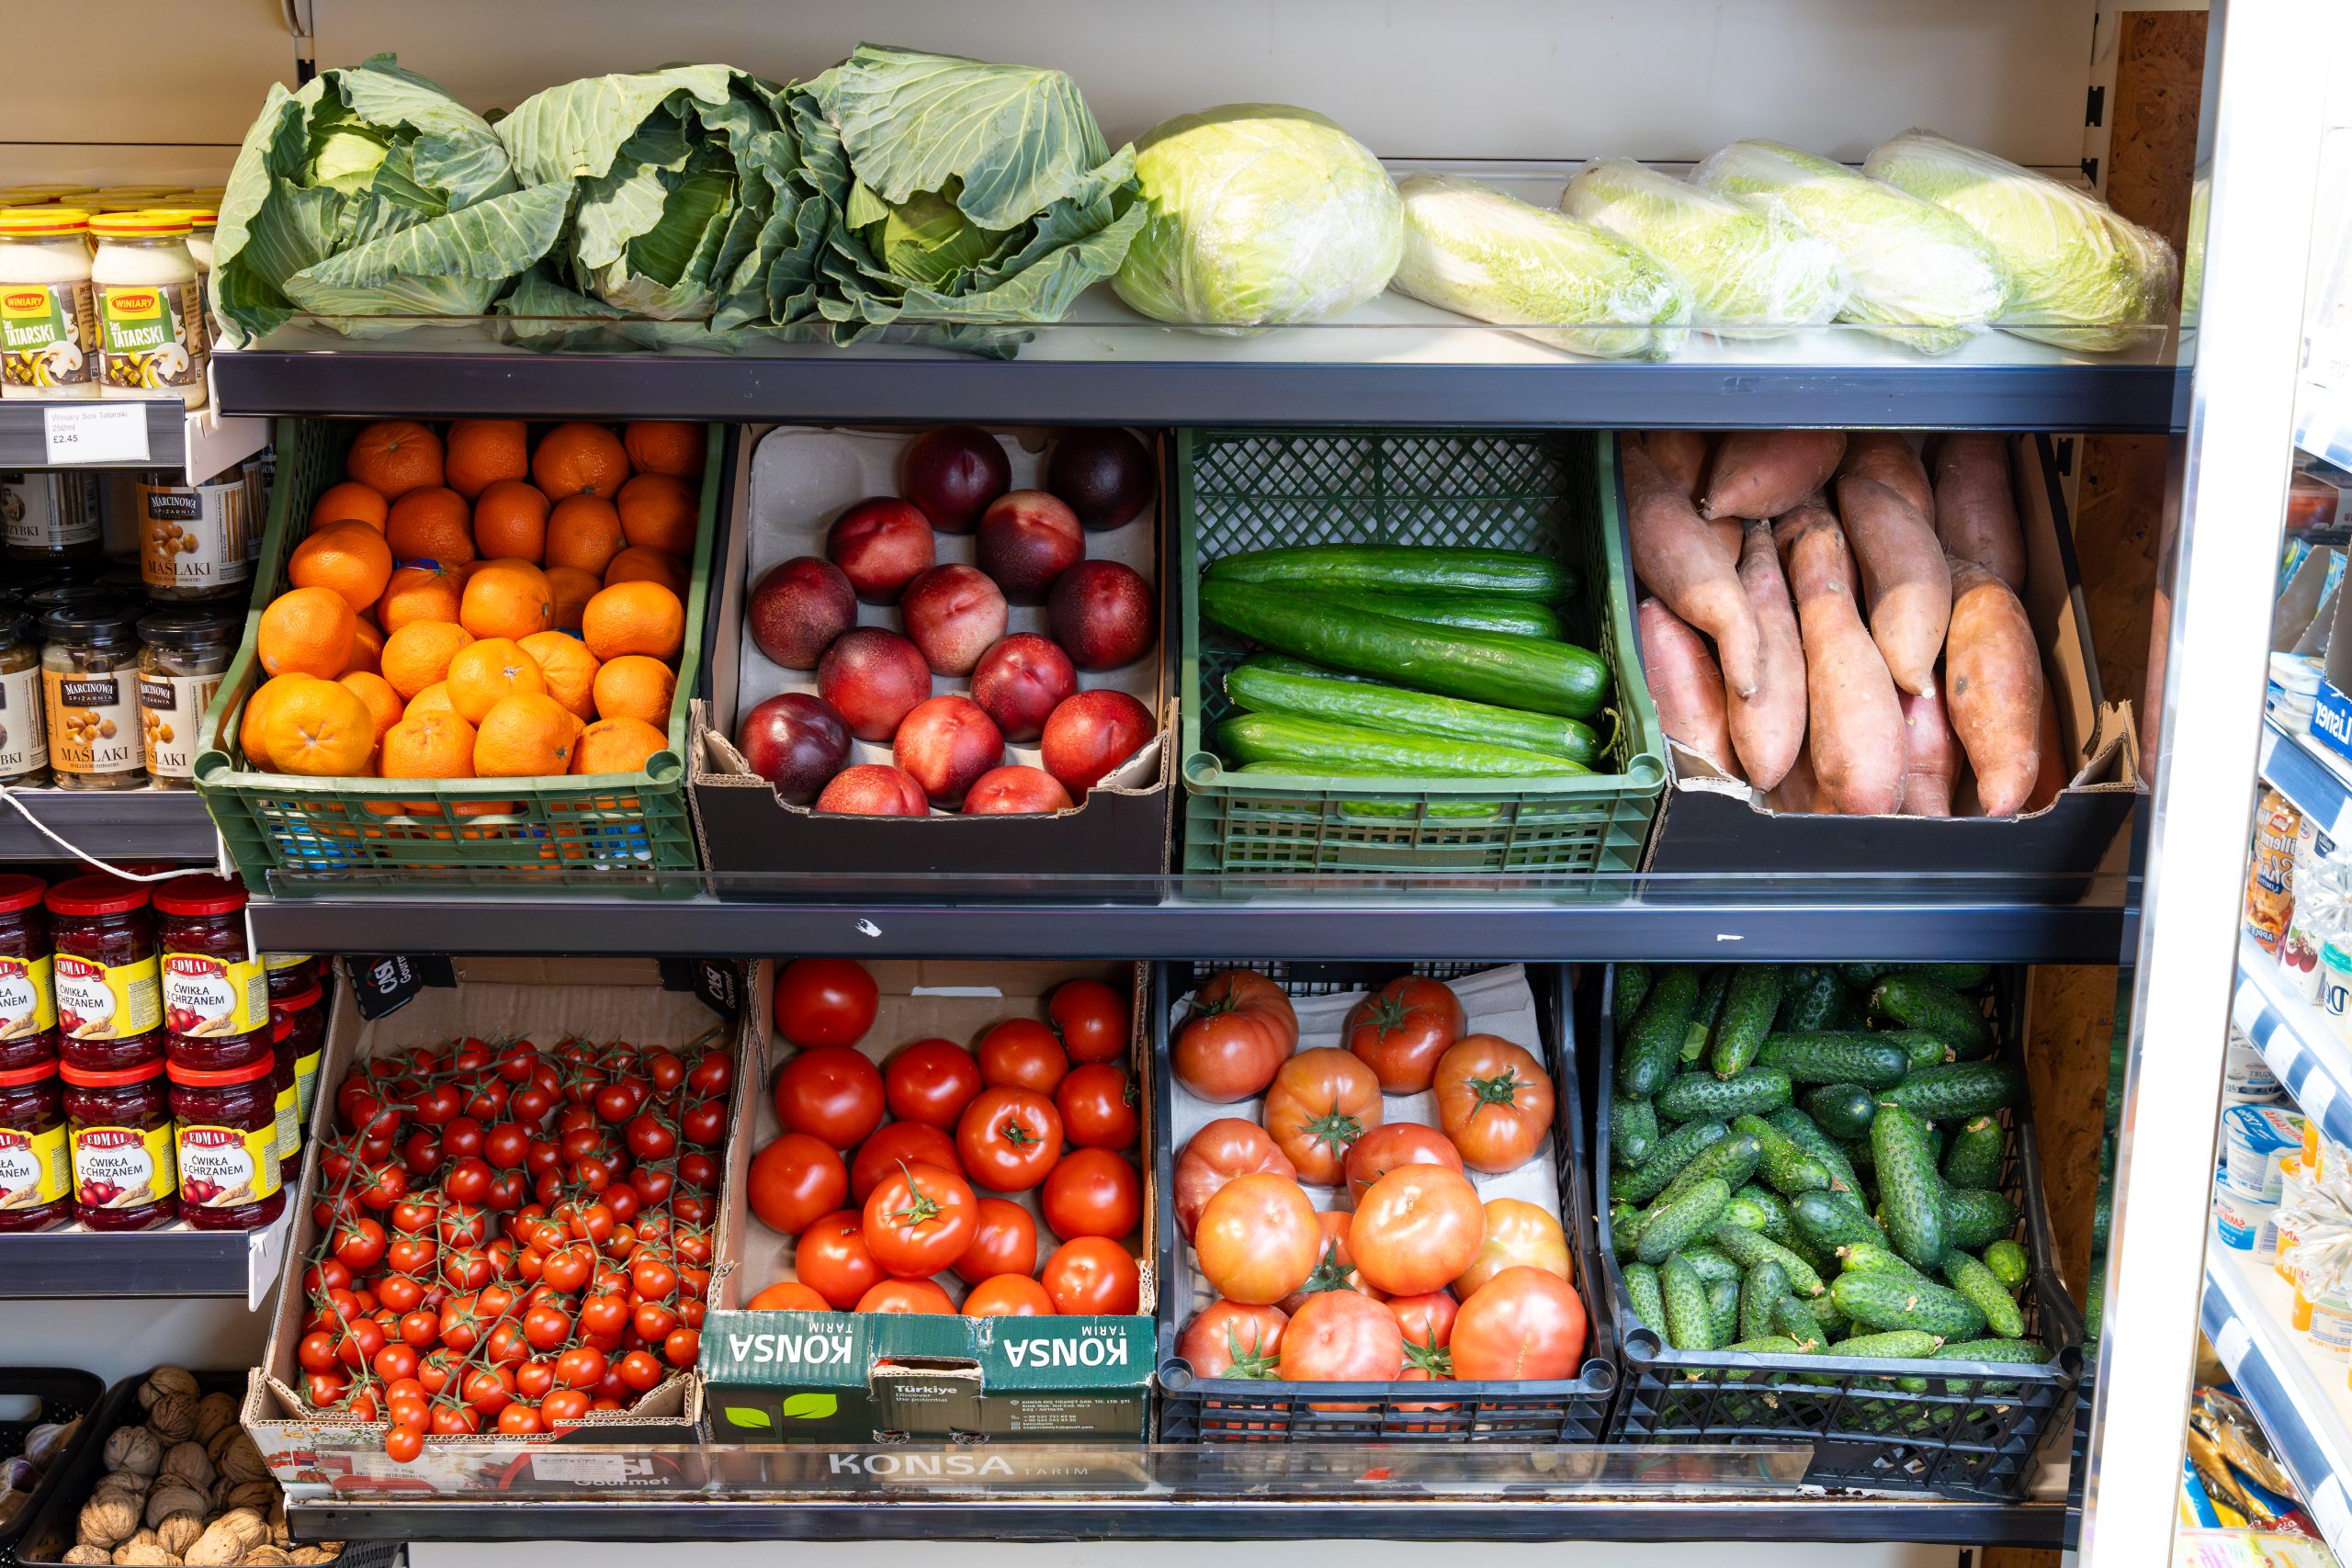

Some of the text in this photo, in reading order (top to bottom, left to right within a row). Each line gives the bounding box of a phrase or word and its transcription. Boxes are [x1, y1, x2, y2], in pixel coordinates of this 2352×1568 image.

[6, 297, 43, 307] WINIARY
[115, 299, 153, 309] WINIARY
[82, 412, 97, 421] Sos
[99, 411, 129, 420] Tatarski
[51, 423, 75, 433] 250ml
[52, 434, 79, 444] £2.45
[151, 495, 197, 510] MARCINOWA
[147, 559, 211, 576] MAŚLAKI
[63, 683, 113, 696] MARCINOWA
[60, 746, 130, 762] MAŚLAKI
[172, 959, 210, 974] EDMAL
[60, 983, 89, 998] ĆWIKŁA
[174, 982, 210, 996] ĆWIKŁA
[58, 994, 105, 1008] CHRZANEM
[171, 993, 225, 1006] CHRZANEM
[86, 1133, 128, 1146] EDMAL
[188, 1131, 228, 1145] EDMAL
[89, 1156, 129, 1168] ĆWIKŁA
[191, 1155, 229, 1167] ĆWIKŁA
[80, 1164, 143, 1177] Z CHRZANEM
[184, 1163, 244, 1176] Z CHRZANEM
[808, 1322, 854, 1334] TARIM
[1081, 1325, 1127, 1337] TARIM
[729, 1333, 853, 1366] KONSA
[1003, 1337, 1128, 1368] KONSA
[895, 1385, 957, 1395] Türkiye
[828, 1453, 1014, 1475] KONSA
[1023, 1468, 1089, 1476] TARIM
